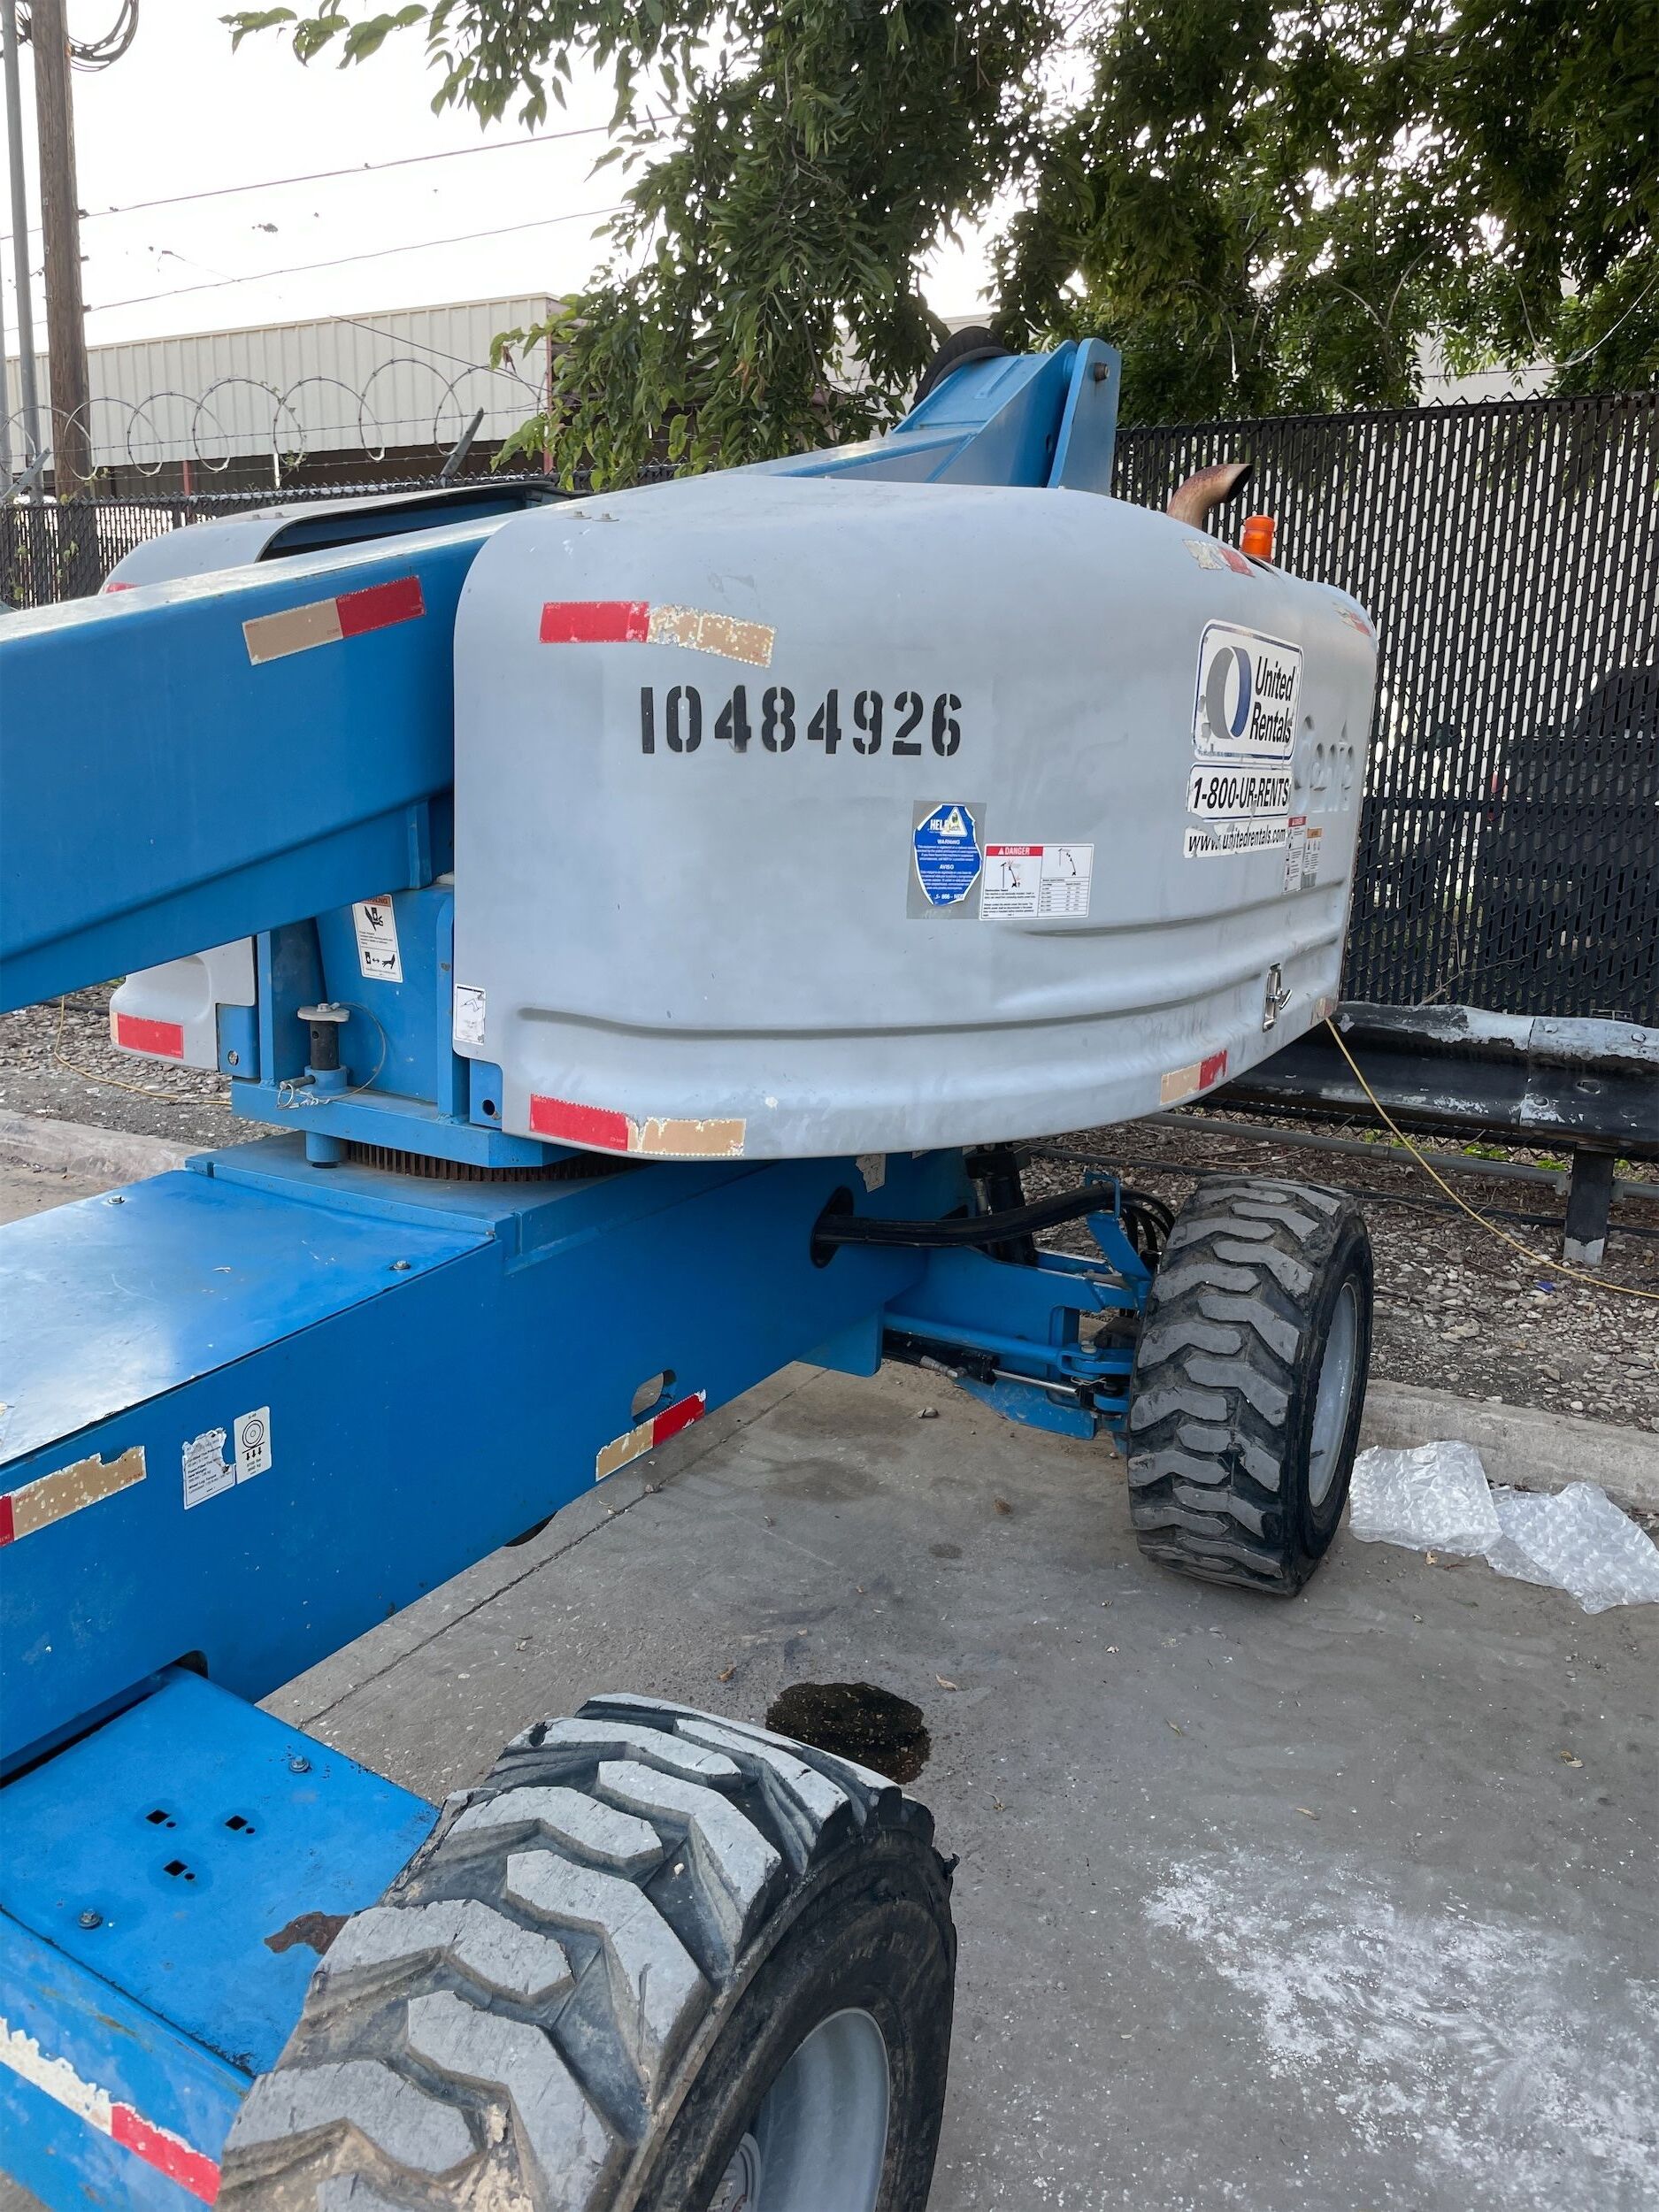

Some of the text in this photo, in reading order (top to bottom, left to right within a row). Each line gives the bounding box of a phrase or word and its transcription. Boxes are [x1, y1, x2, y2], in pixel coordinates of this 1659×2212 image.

[1255, 656, 1295, 702] United
[641, 685, 962, 757] 10484926
[1249, 702, 1291, 743] Rentals
[1194, 777, 1289, 809] 1-800-UR-RENTS
[1004, 847, 1030, 856] DANGER
[1188, 825, 1286, 851] wwwunitedrentals.com
